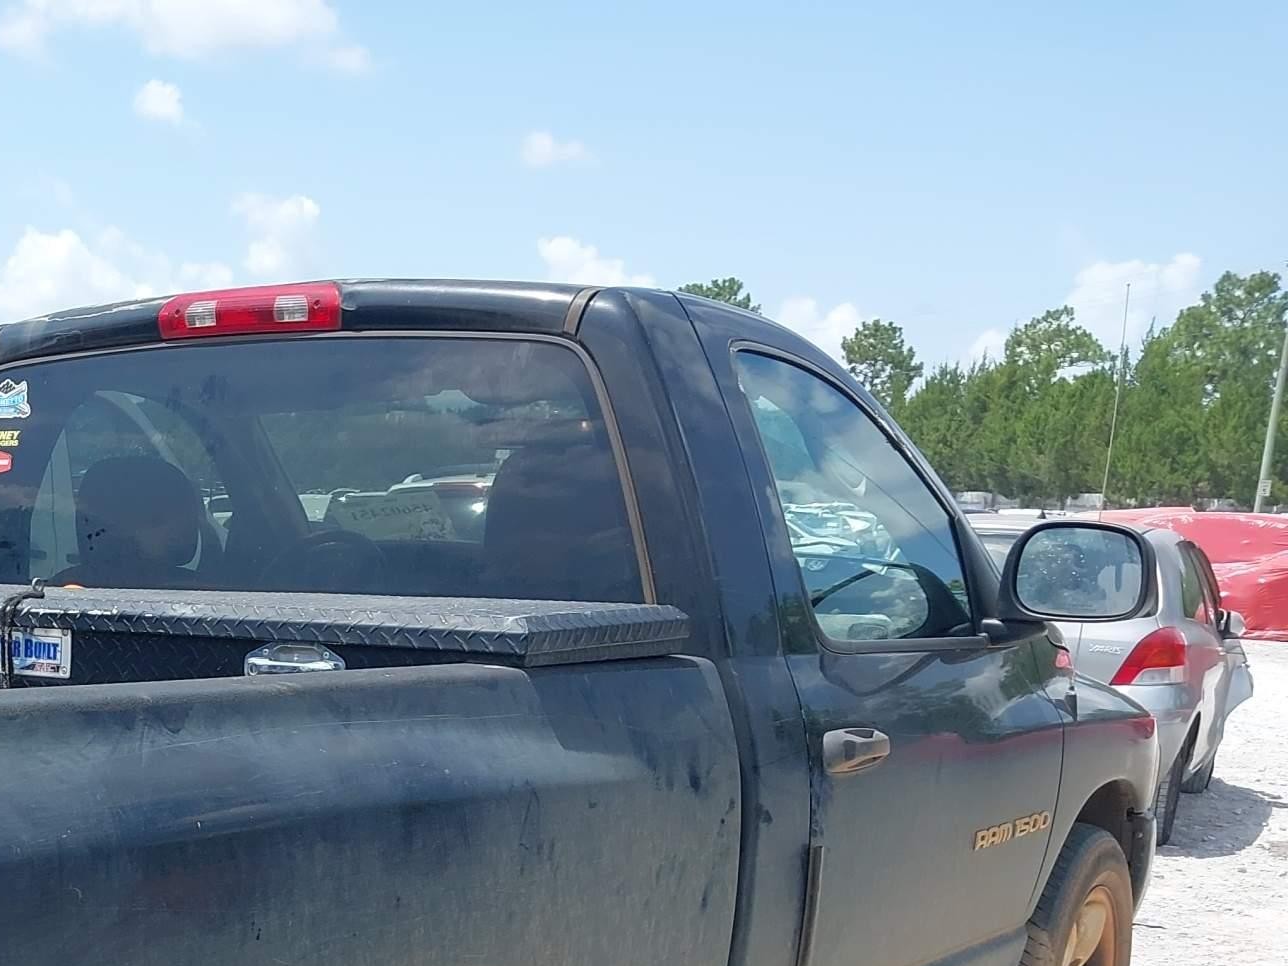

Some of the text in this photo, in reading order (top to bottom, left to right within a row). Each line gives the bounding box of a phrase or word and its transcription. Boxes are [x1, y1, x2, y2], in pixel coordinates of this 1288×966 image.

[24, 639, 58, 660] BUILT
[973, 811, 1051, 851] RAM 1500
